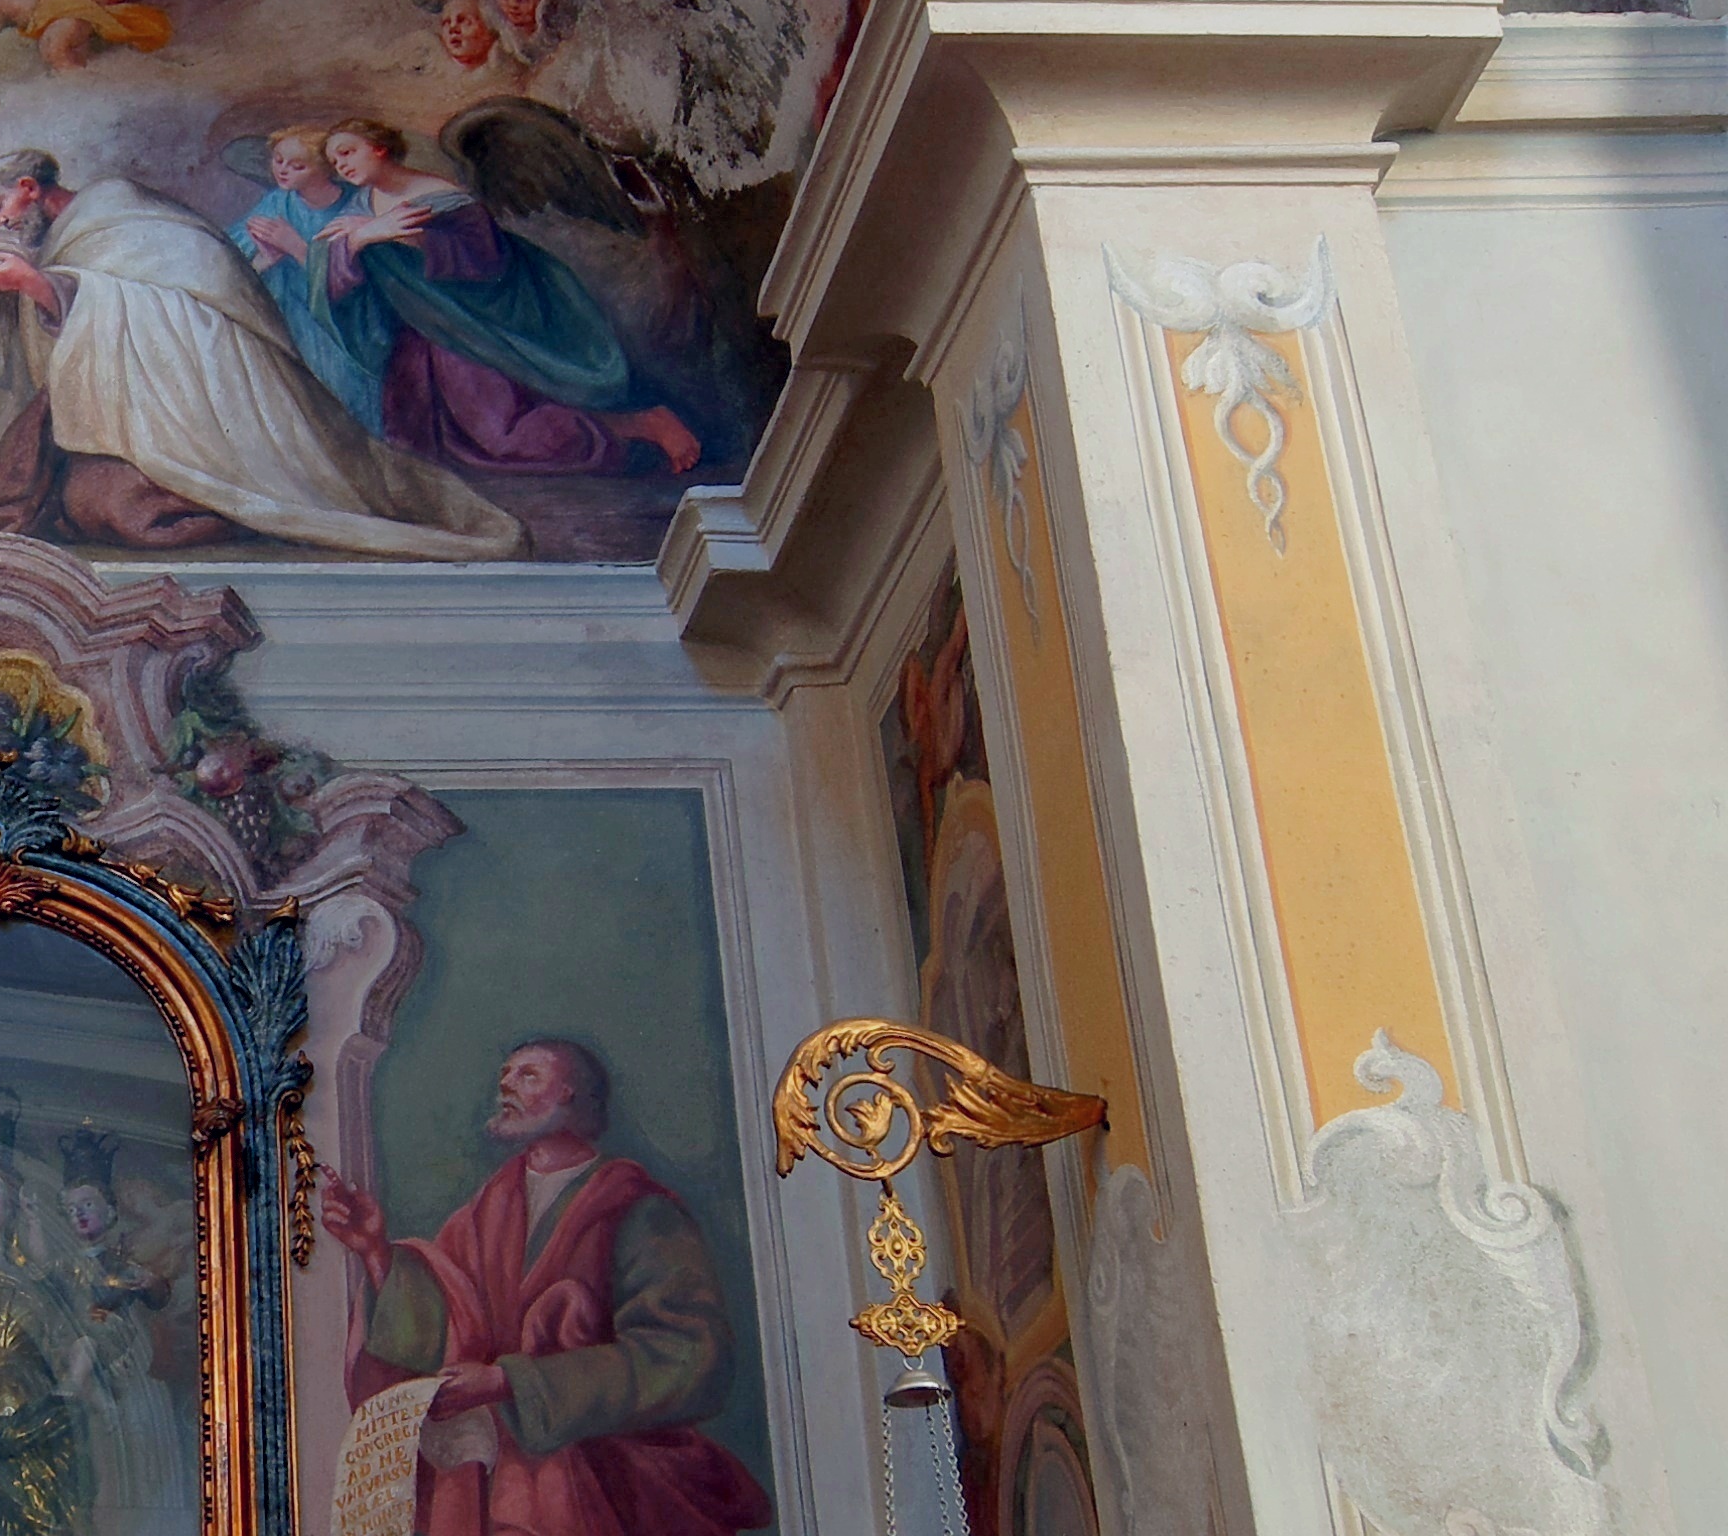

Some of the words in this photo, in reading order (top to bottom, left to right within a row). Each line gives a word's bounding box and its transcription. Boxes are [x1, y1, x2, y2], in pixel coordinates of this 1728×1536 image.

[355, 1408, 411, 1443] MITTE
[347, 1463, 371, 1487] AD
[379, 1445, 408, 1469] ME
